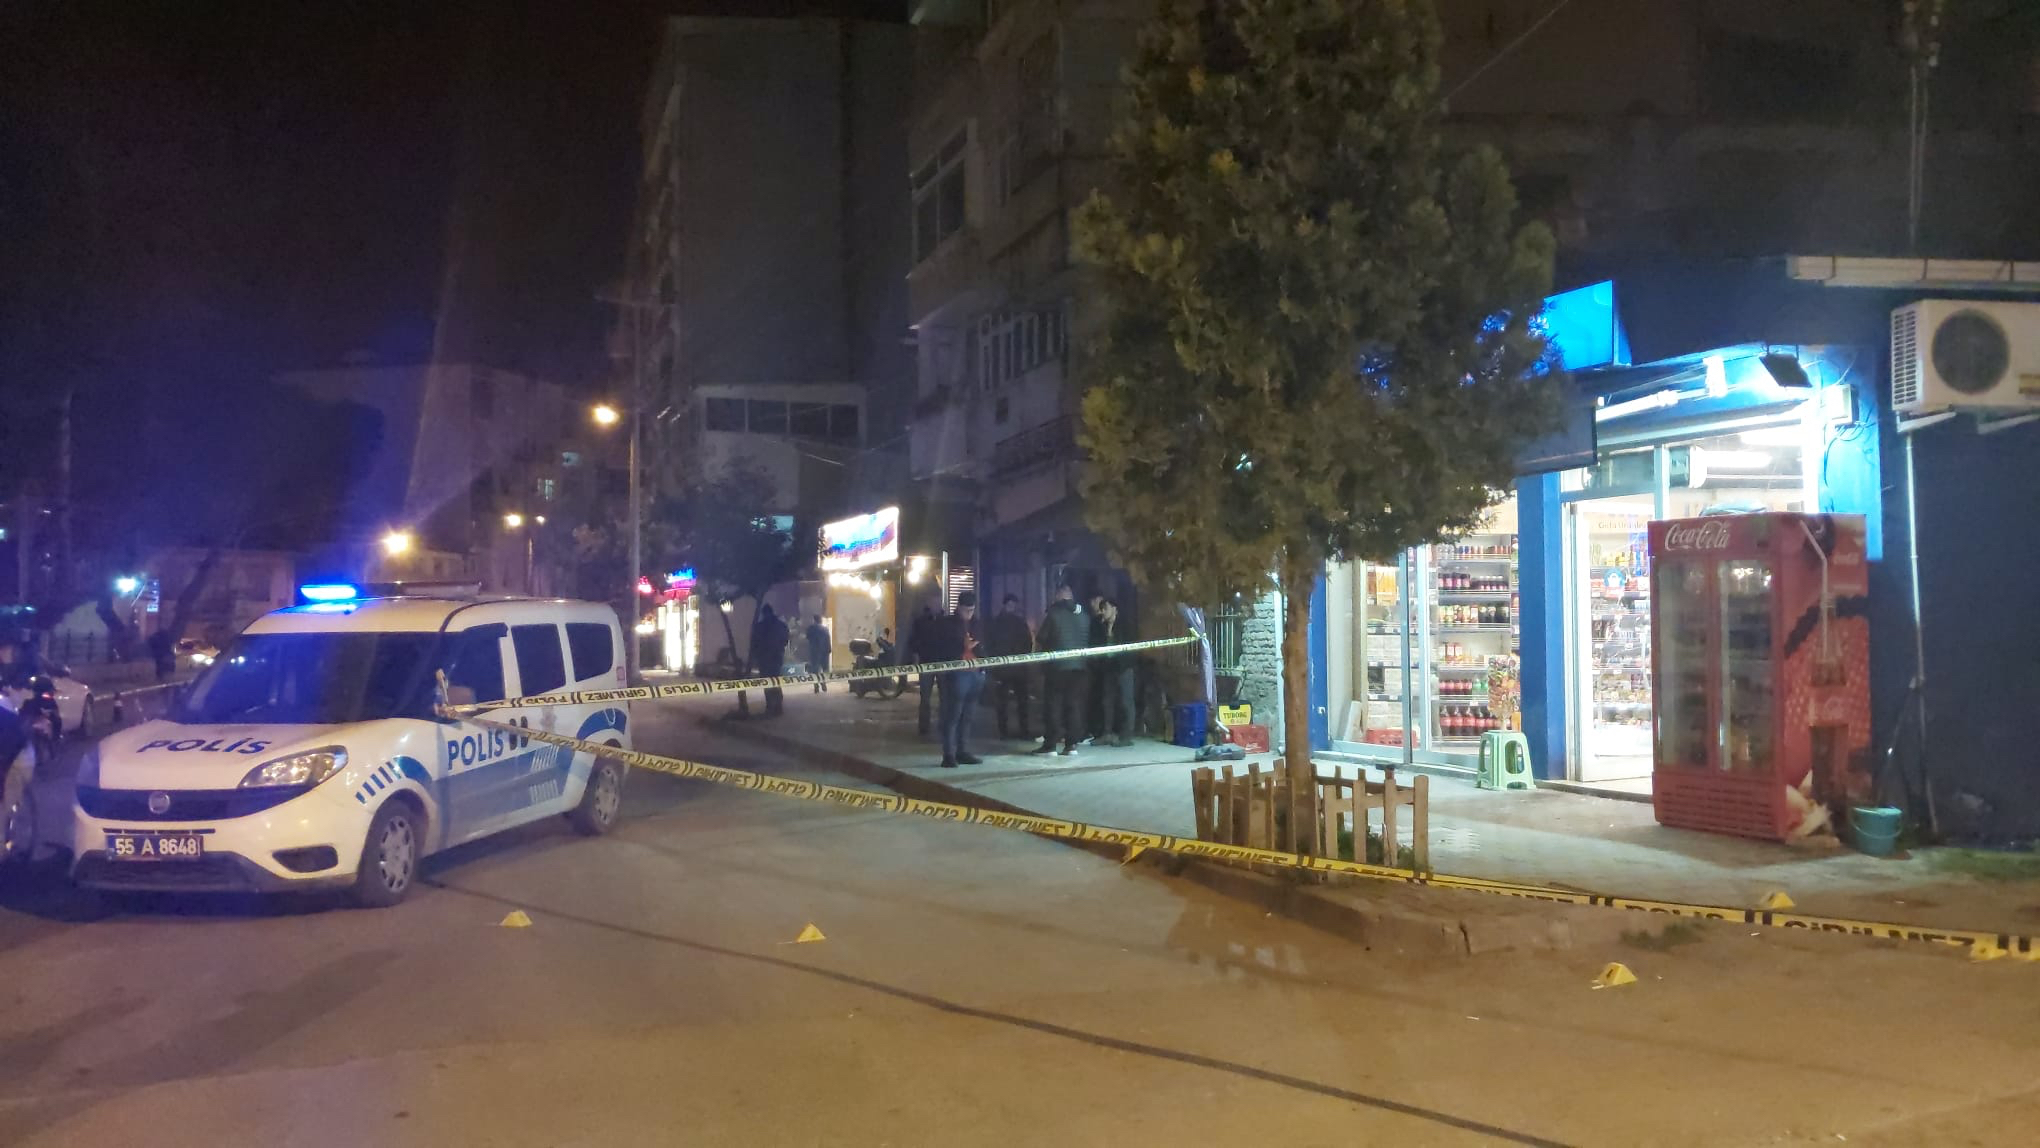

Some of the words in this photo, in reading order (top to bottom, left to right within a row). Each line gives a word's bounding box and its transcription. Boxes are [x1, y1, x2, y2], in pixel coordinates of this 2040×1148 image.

[115, 838, 135, 855] 55
[141, 838, 155, 855] A
[159, 838, 197, 855] 8648
